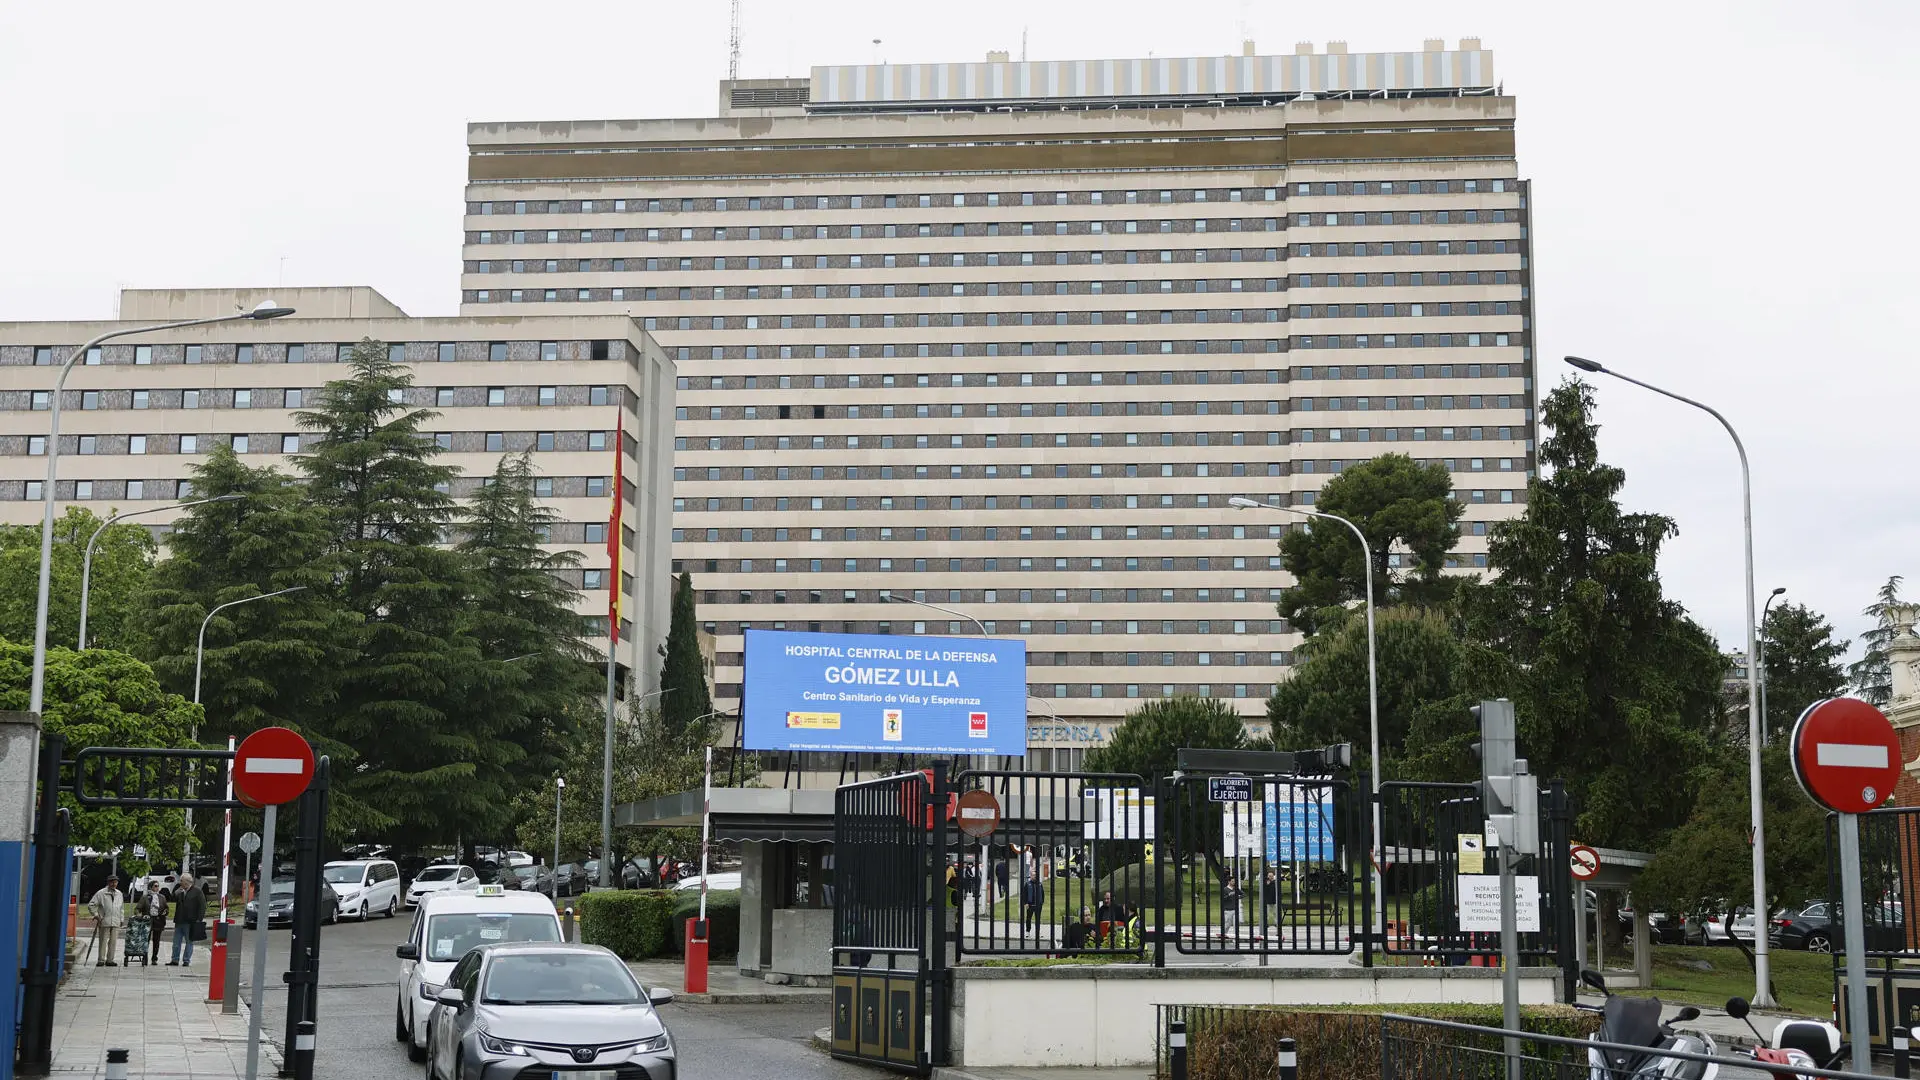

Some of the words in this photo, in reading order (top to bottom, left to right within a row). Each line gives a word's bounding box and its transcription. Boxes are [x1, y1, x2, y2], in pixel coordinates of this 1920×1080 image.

[785, 645, 844, 658] HOSPITAL
[847, 647, 903, 660] CENTRAL
[905, 649, 922, 661] DE
[925, 650, 940, 661] LA
[942, 651, 997, 663] DEFENSA
[824, 662, 900, 686] GÓMEZ
[906, 669, 960, 687] ULLA
[803, 691, 836, 702] Centro
[838, 692, 882, 703] Sanitario
[884, 693, 896, 703] de
[899, 694, 921, 704] Vida
[922, 696, 929, 706] y
[931, 695, 981, 706] Esperanza
[1028, 726, 1104, 742] EFENSA
[1213, 790, 1248, 800] EJERCITO
